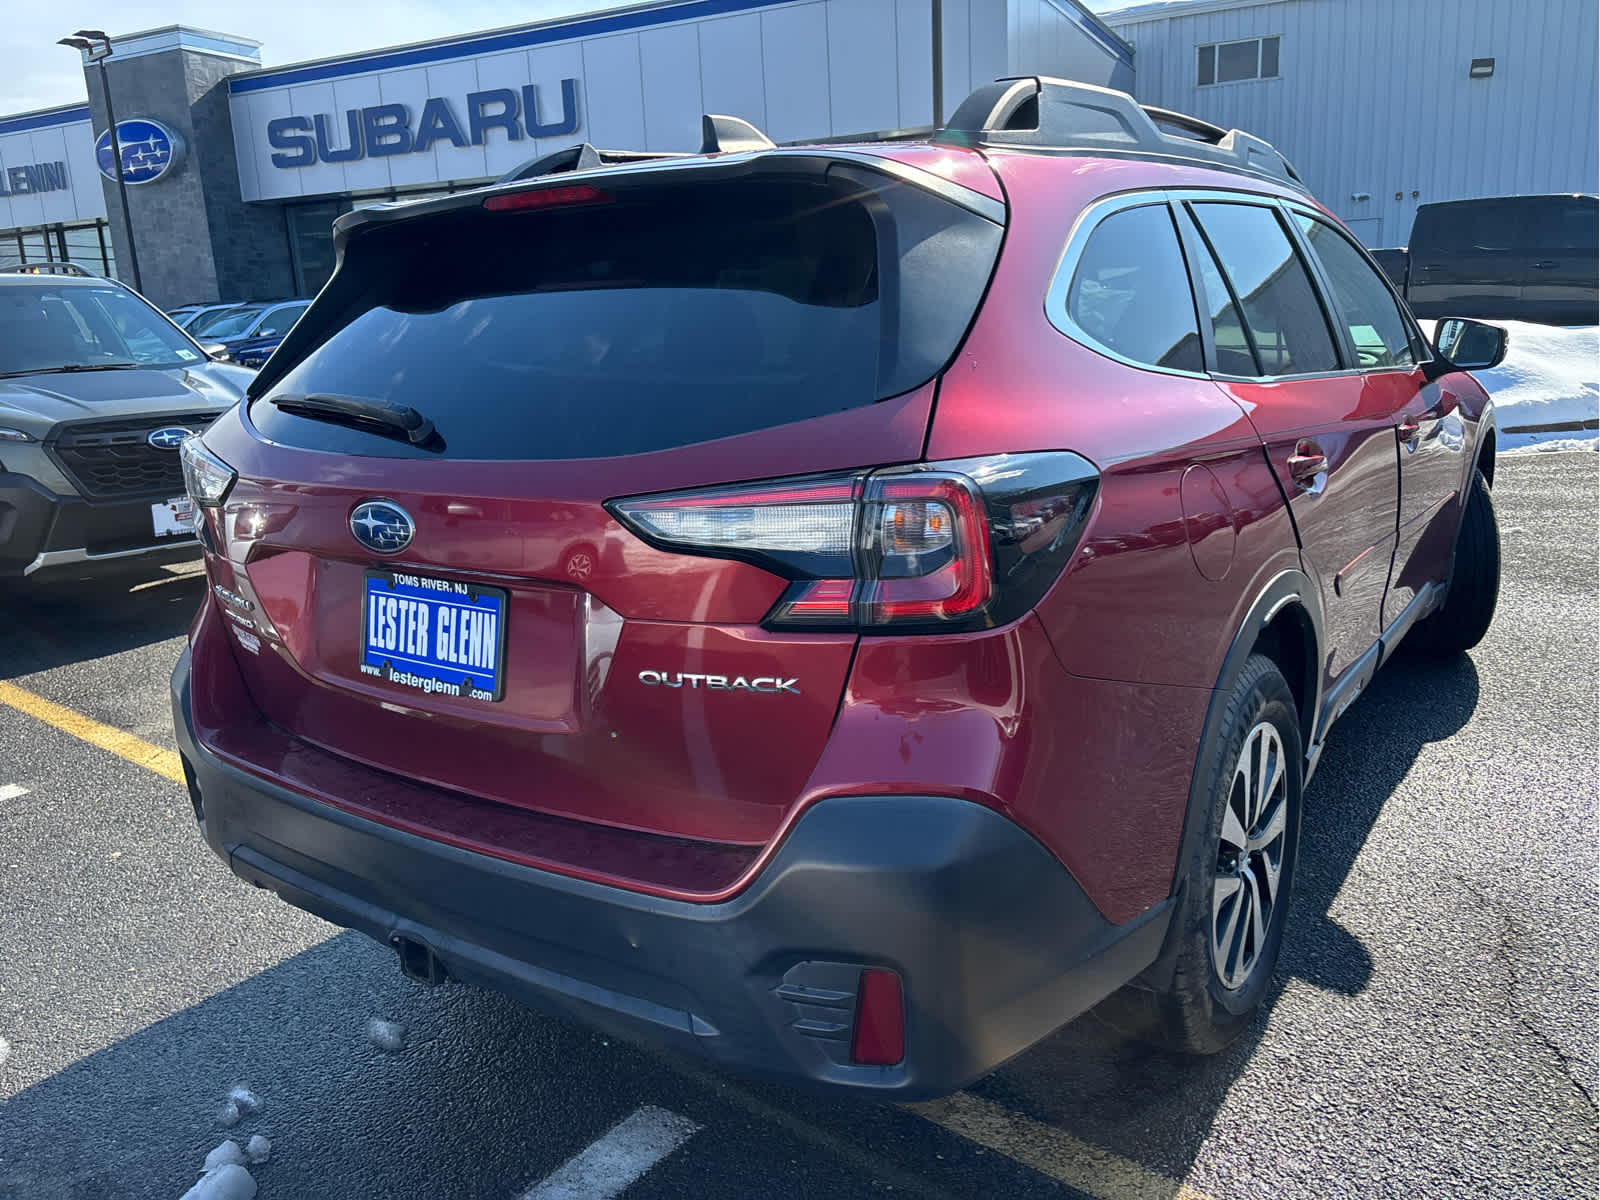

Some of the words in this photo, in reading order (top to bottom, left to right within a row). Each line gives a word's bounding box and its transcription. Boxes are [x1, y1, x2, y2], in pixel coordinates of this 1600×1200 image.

[267, 78, 579, 169] SUBARU
[393, 573, 419, 588] TOMS
[455, 583, 468, 595] NJ
[369, 595, 429, 657] LESTER
[436, 606, 497, 669] GLENN
[638, 670, 801, 694] OUTBACK
